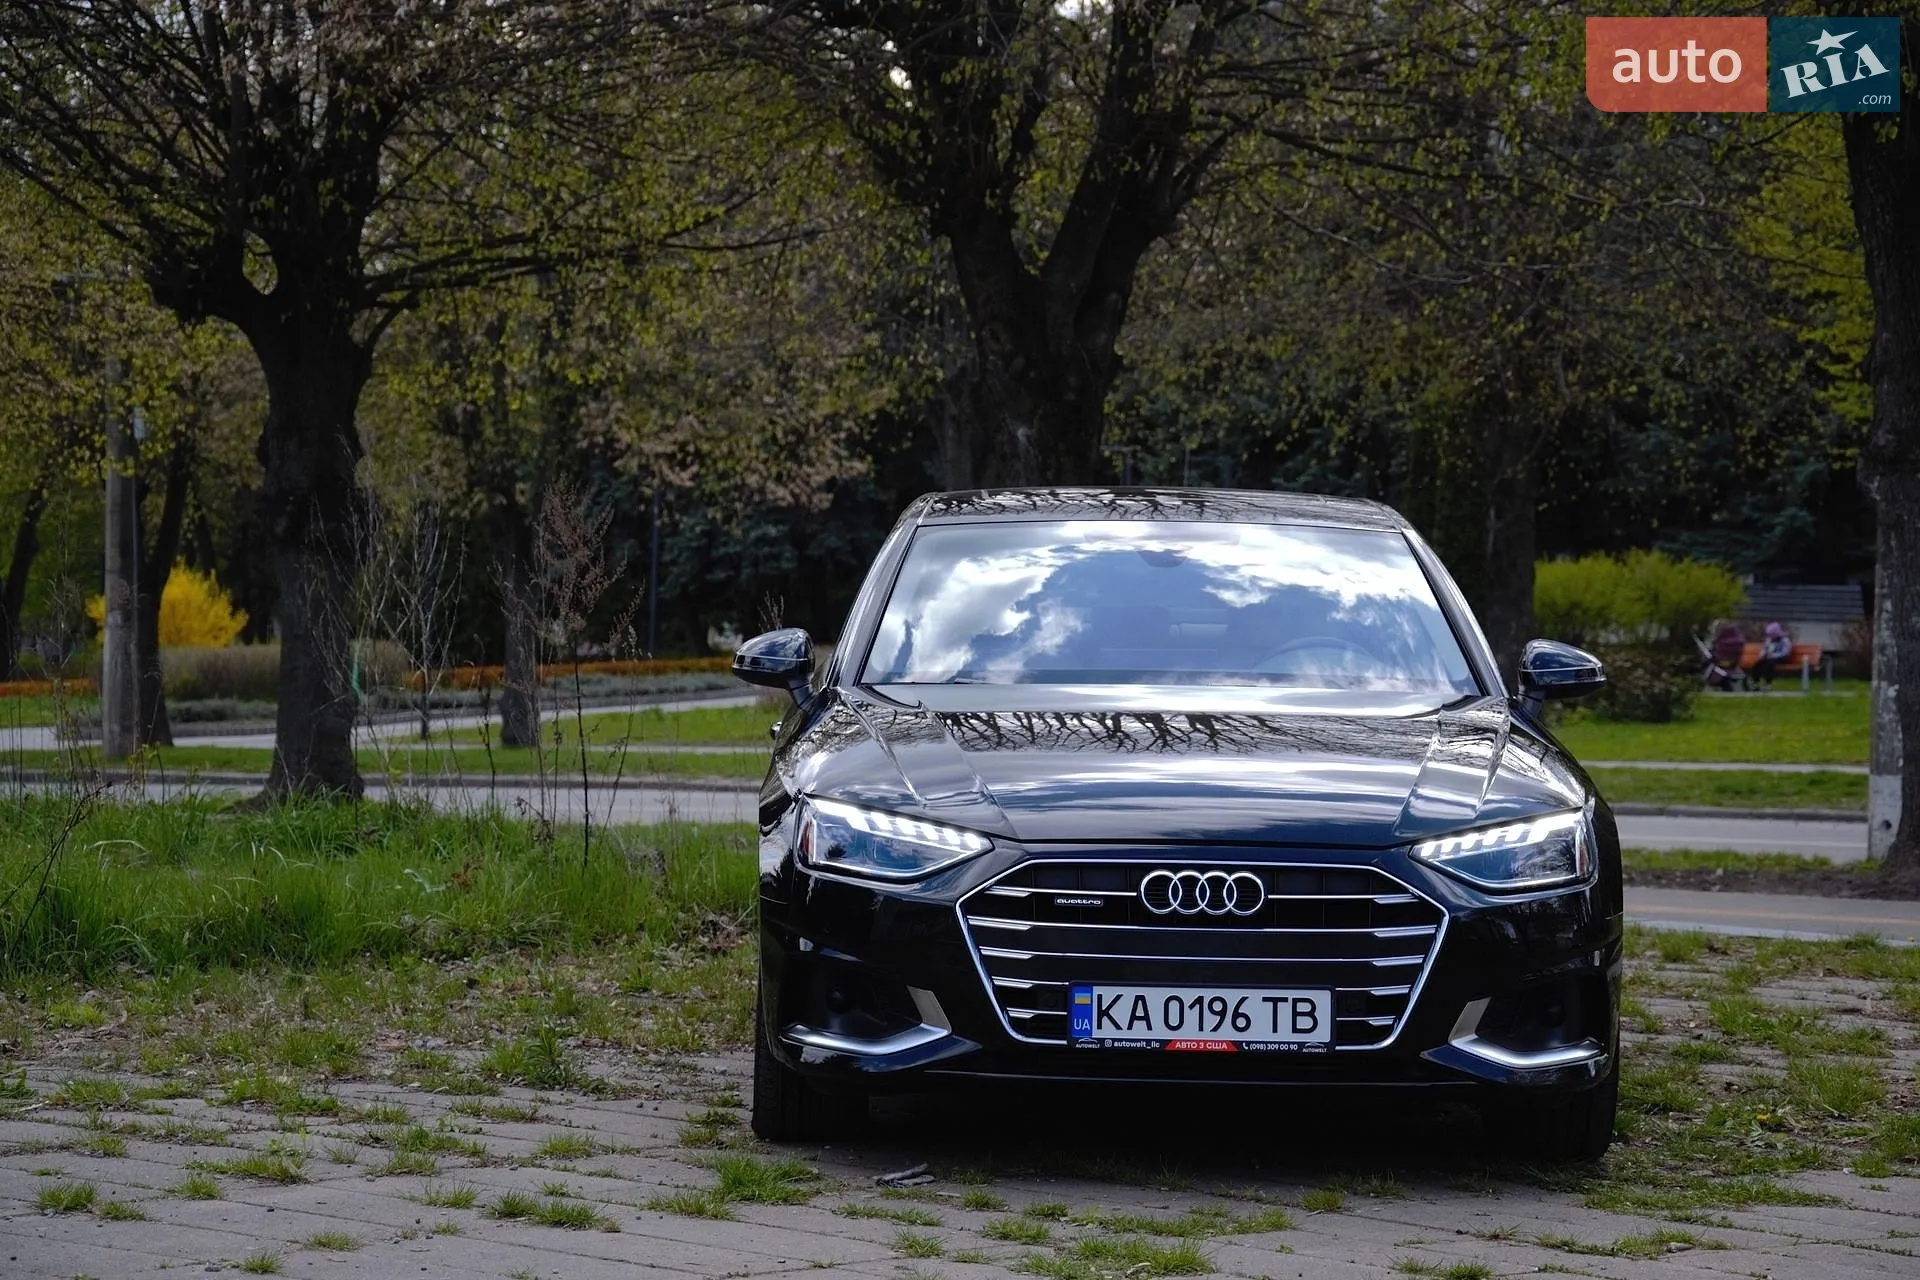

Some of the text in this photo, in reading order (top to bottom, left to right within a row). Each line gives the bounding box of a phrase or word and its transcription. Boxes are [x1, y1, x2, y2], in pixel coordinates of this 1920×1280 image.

[1074, 1018, 1091, 1031] UA
[1096, 993, 1319, 1034] KA 0196 TB
